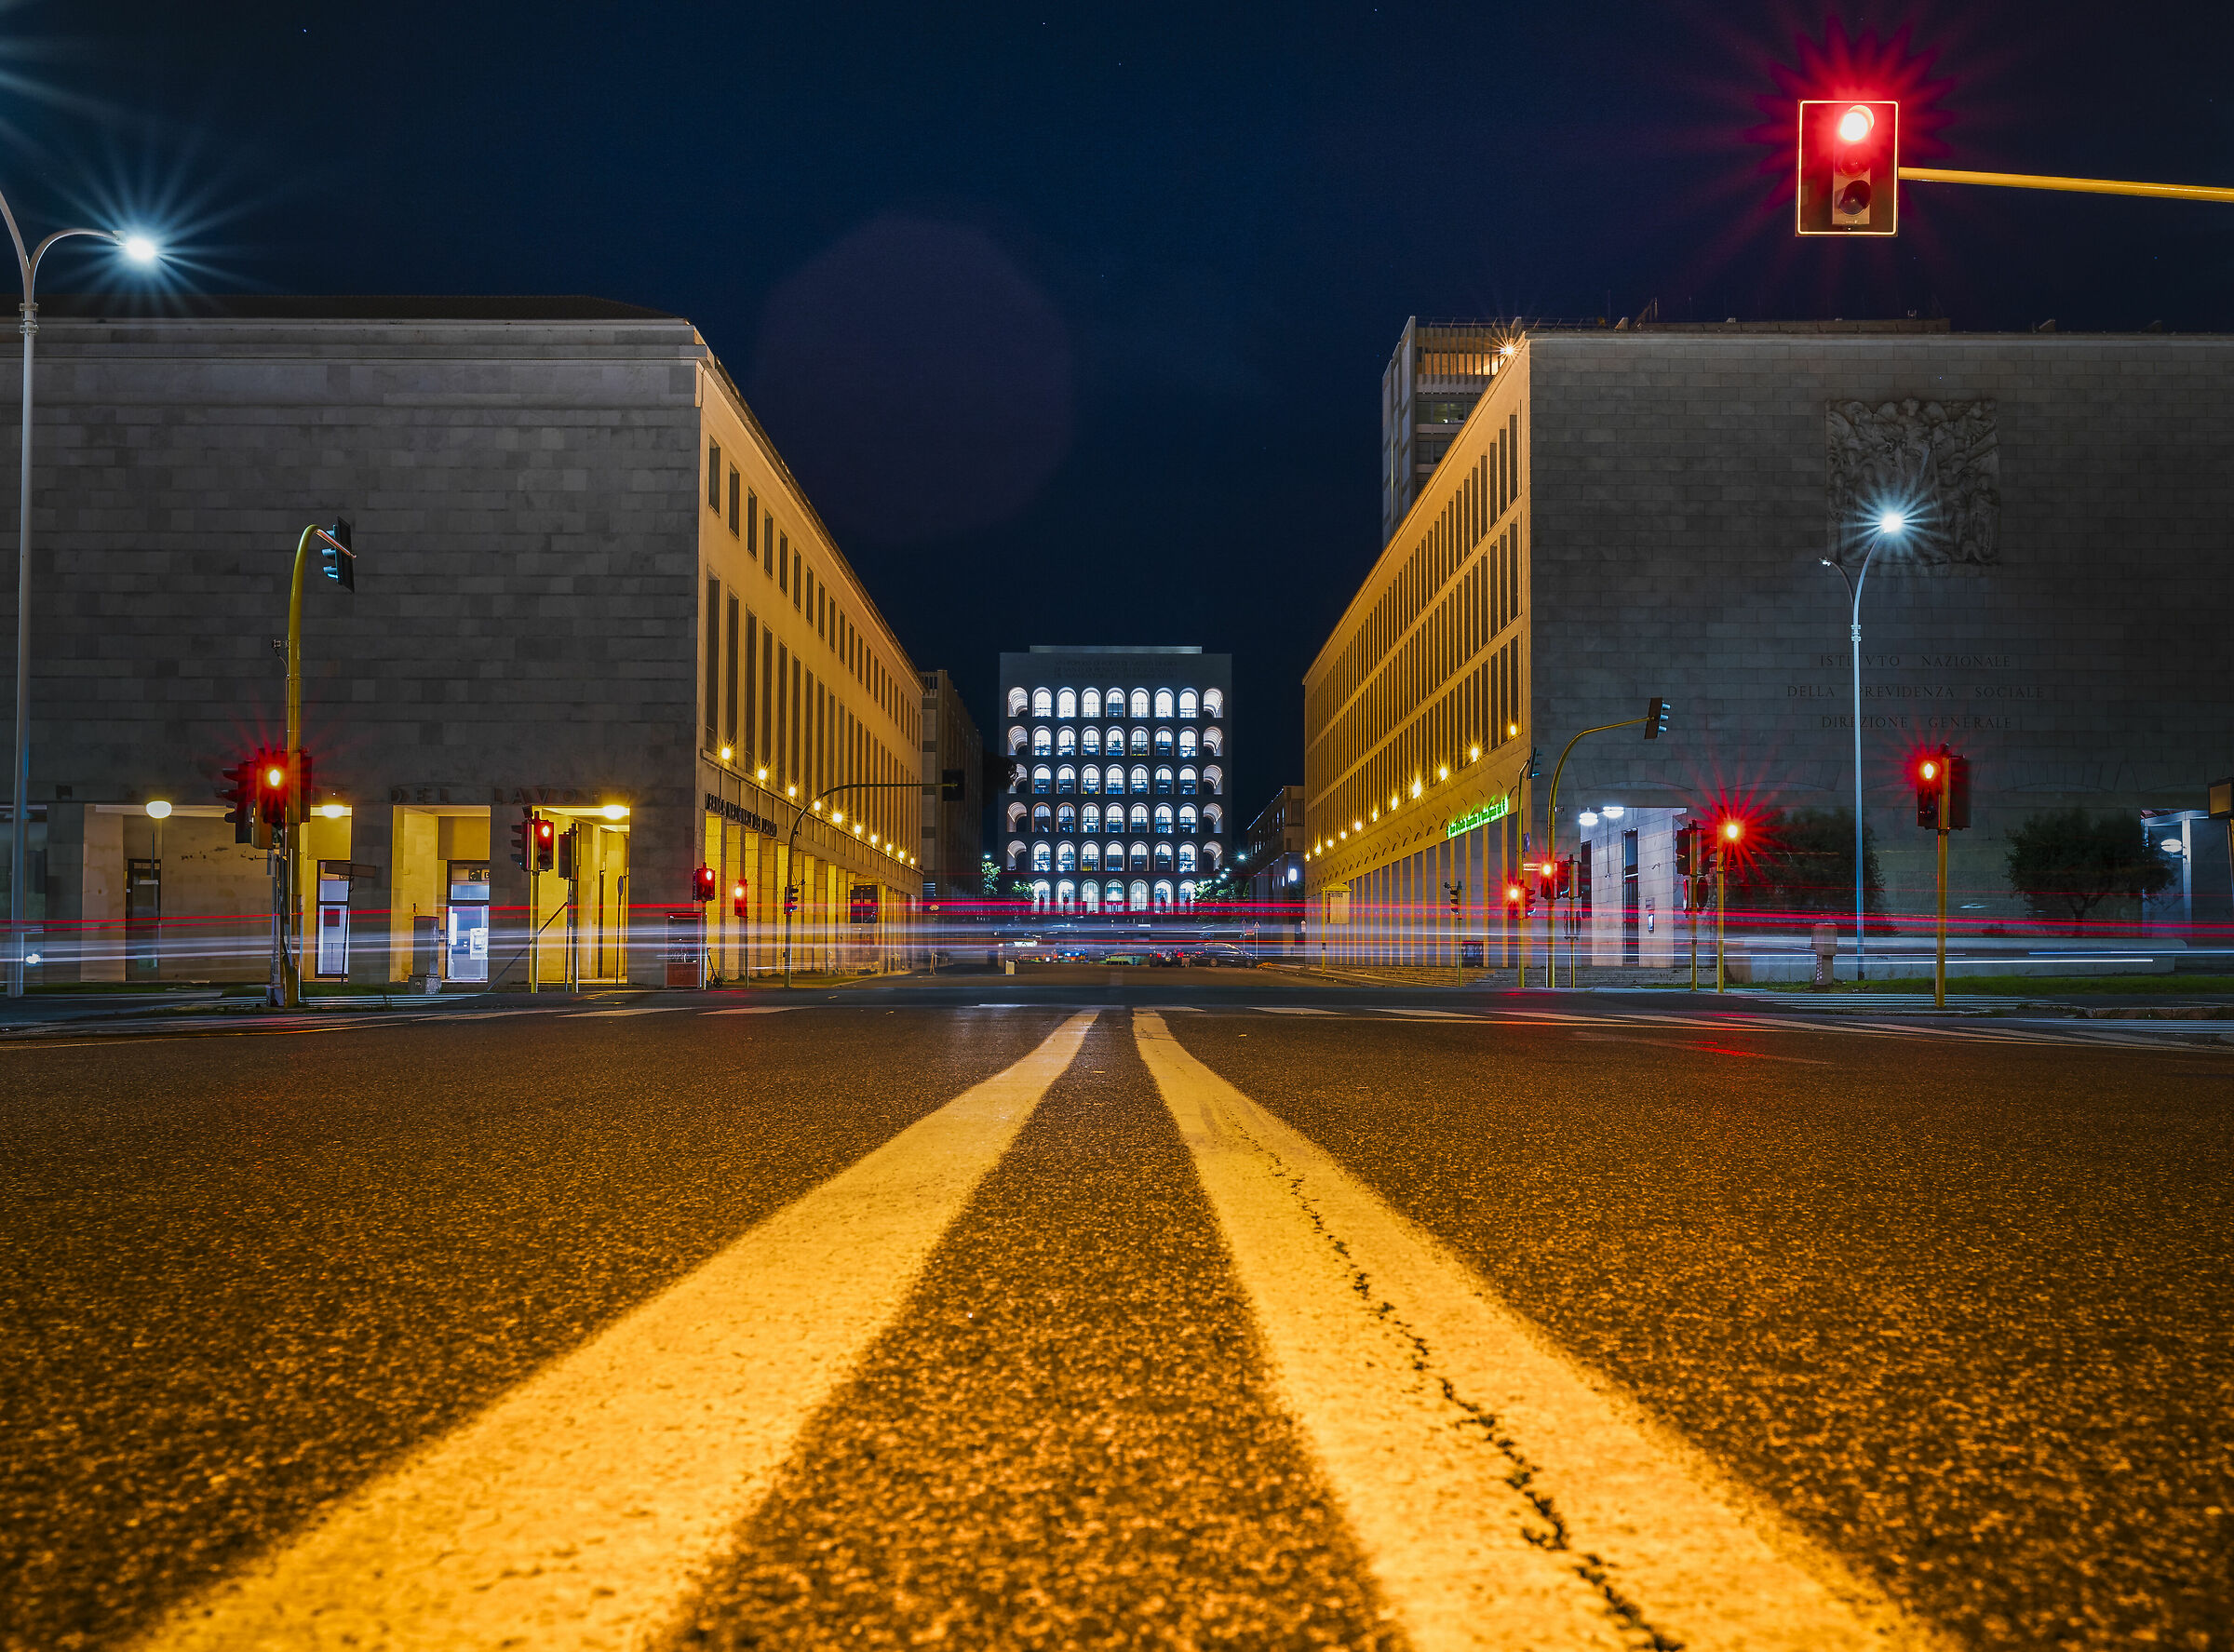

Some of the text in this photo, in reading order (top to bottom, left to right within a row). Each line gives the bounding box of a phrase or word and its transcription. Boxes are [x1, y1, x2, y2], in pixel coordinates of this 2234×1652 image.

[1820, 654, 2011, 667] ISTIVTO NAZIONALE
[1786, 685, 1836, 698] DELLA
[1974, 686, 2044, 698] SOCIALE
[1822, 716, 2012, 729] DIREZIONE GENERALE
[388, 787, 451, 804] DEL
